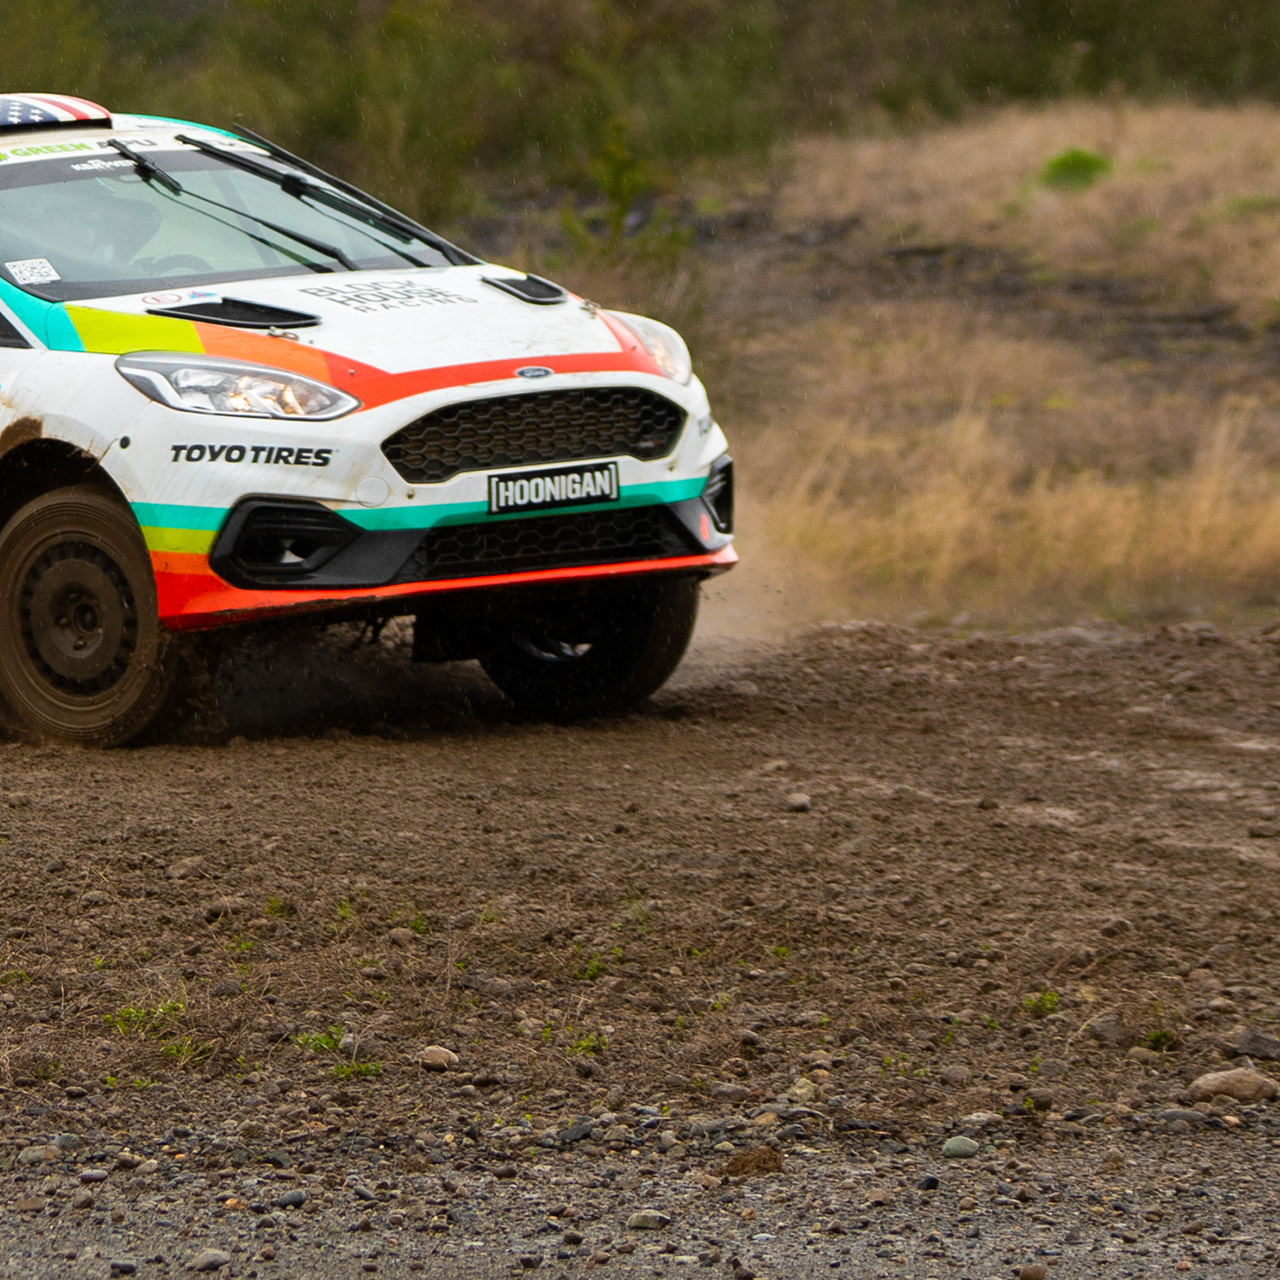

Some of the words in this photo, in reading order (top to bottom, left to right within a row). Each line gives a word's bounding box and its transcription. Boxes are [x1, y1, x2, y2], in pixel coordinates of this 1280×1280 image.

[10, 141, 93, 158] GREEN
[298, 279, 425, 298] BLOCK
[326, 287, 461, 307] HOUSE
[353, 296, 479, 314] RACING
[171, 444, 247, 463] TOYO
[251, 445, 333, 467] TIRES
